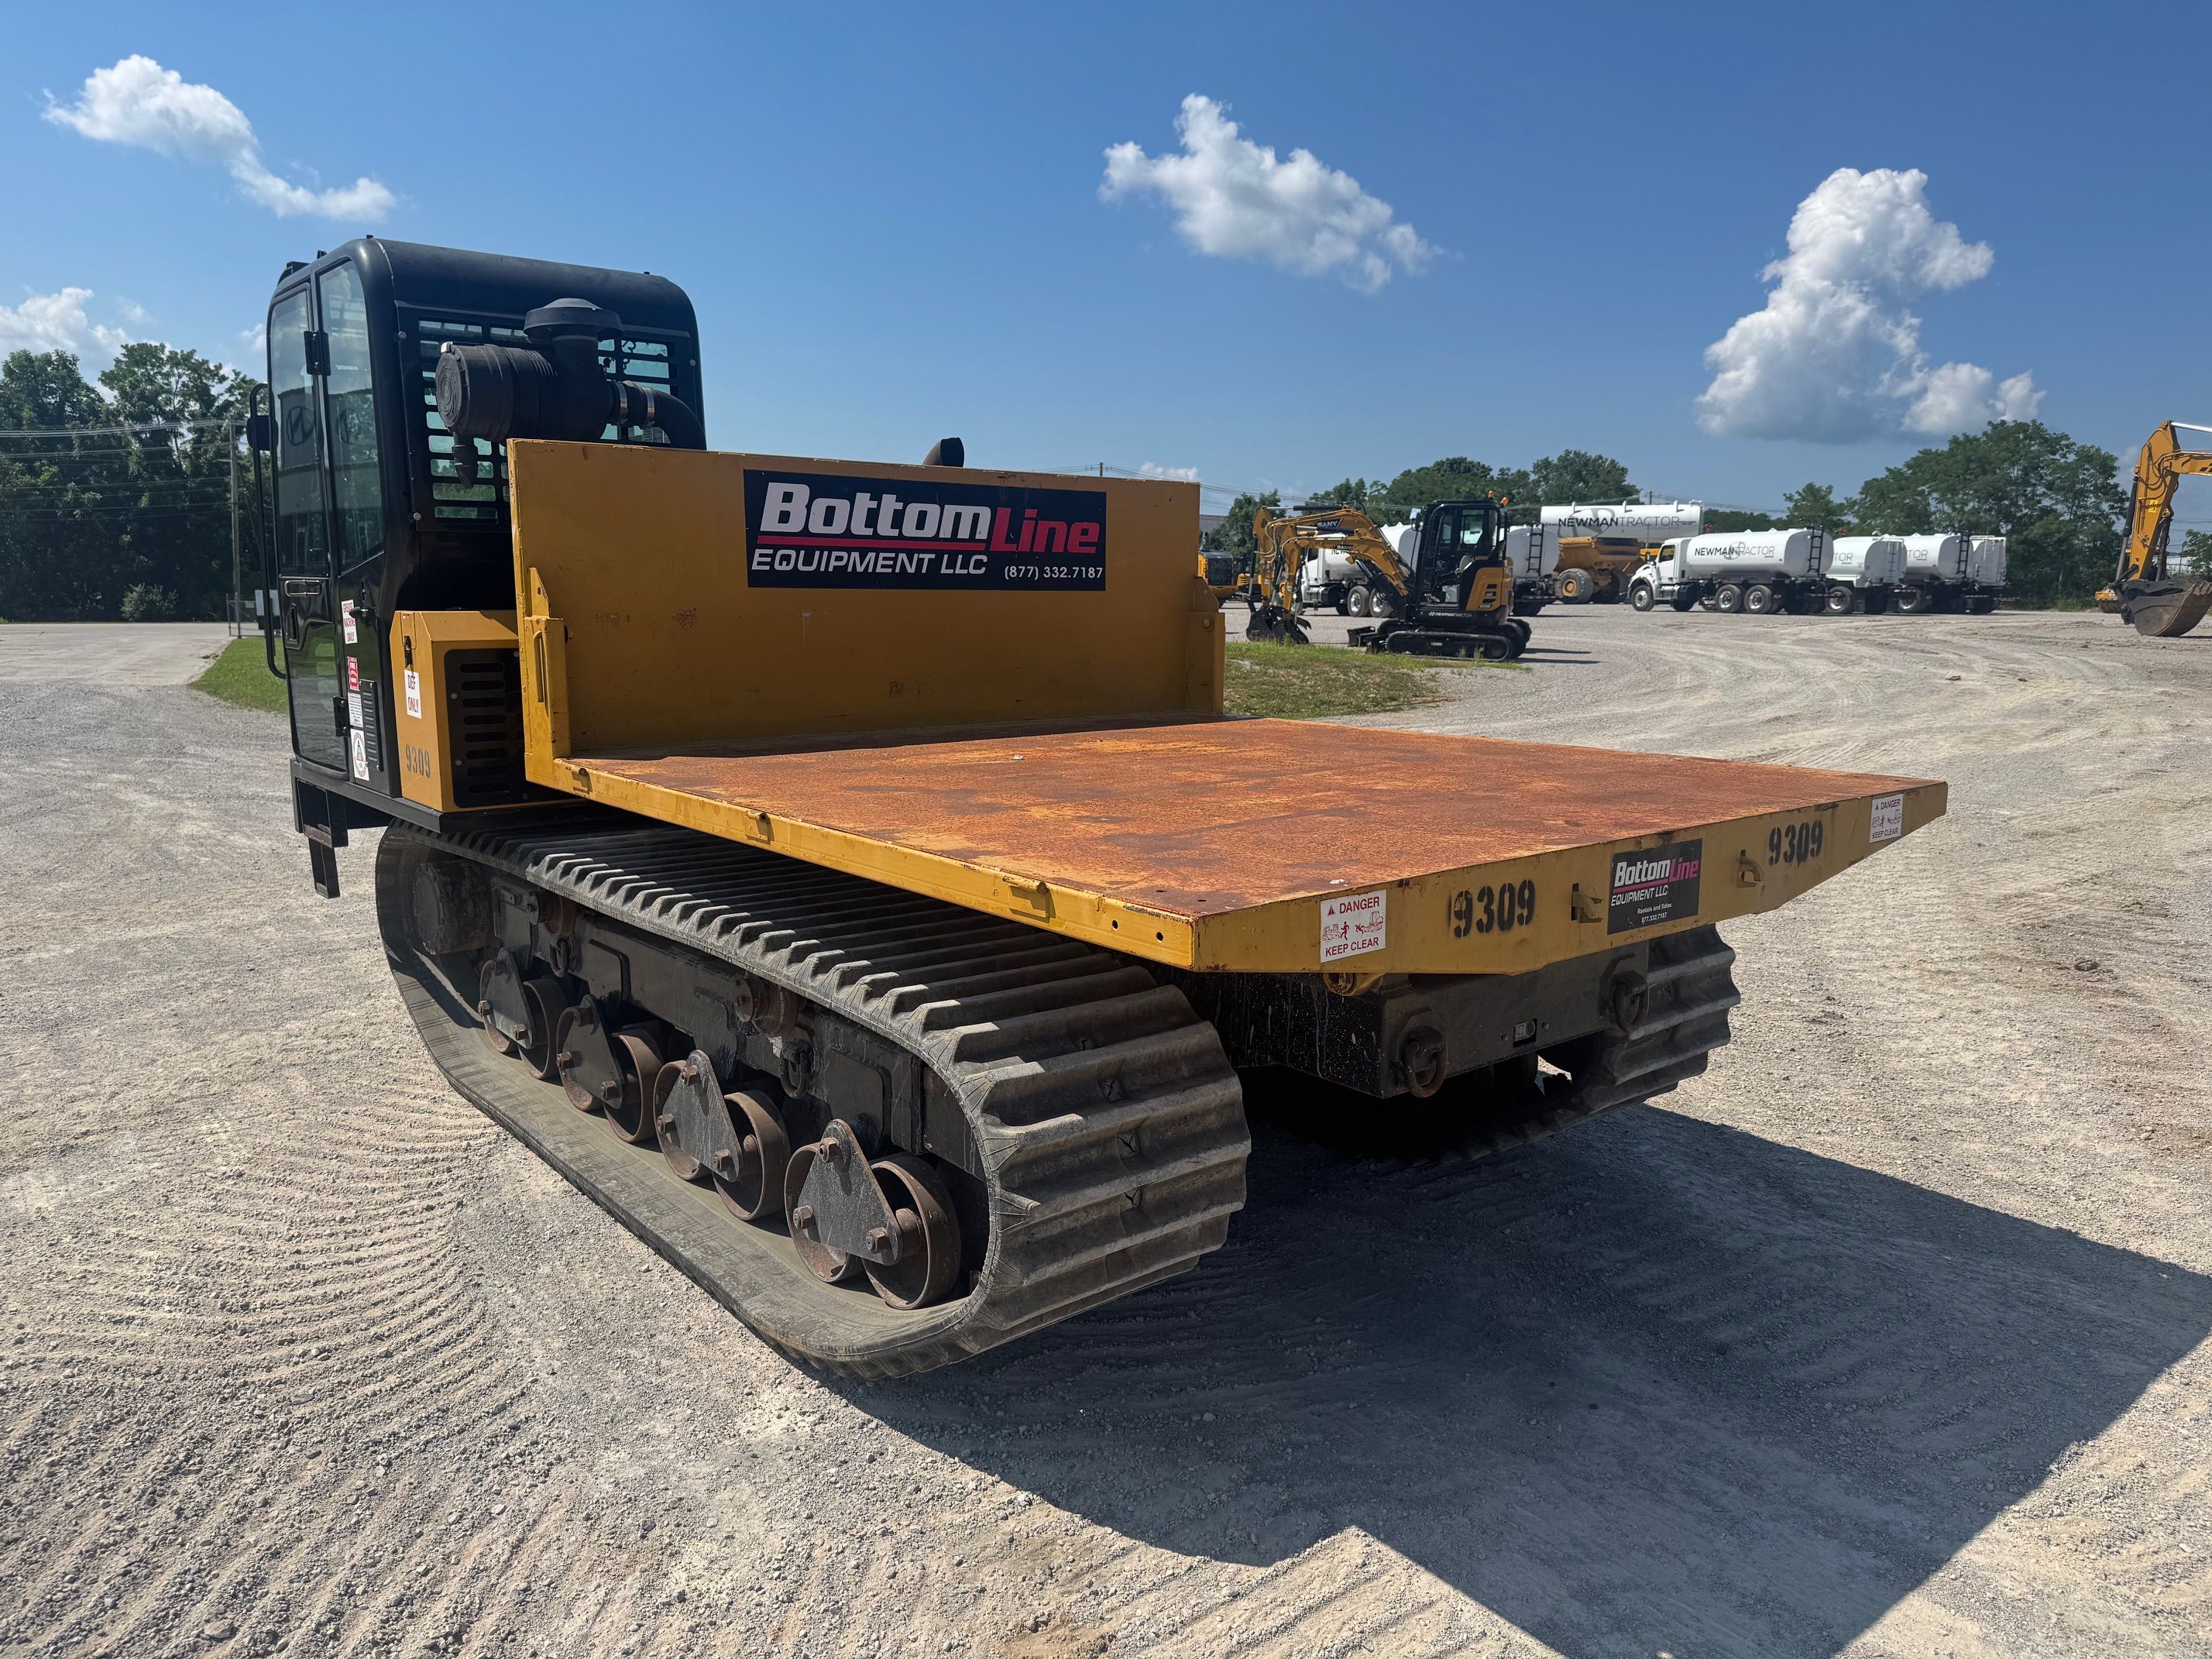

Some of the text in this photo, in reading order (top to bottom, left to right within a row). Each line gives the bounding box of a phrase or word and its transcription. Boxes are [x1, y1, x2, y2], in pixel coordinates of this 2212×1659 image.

[751, 548, 988, 575] EQUIPMENT LLC
[1004, 565, 1104, 581] (877) 332.7187
[346, 631, 355, 642] DAILY
[407, 674, 416, 690] DEF
[407, 696, 419, 713] ONLY
[404, 744, 431, 778] 9309
[1881, 799, 1901, 810] DANGER
[1872, 827, 1898, 839] KEEP CLEAR
[1767, 819, 1824, 867] 9309
[1610, 884, 1669, 907] EQUIPMENT LLC
[1339, 896, 1380, 915] DANGER
[1452, 878, 1536, 938] 9309
[1637, 906, 1653, 915] Rentals
[1661, 902, 1672, 910] Sales
[1325, 936, 1379, 957] KEEP CLEAR
